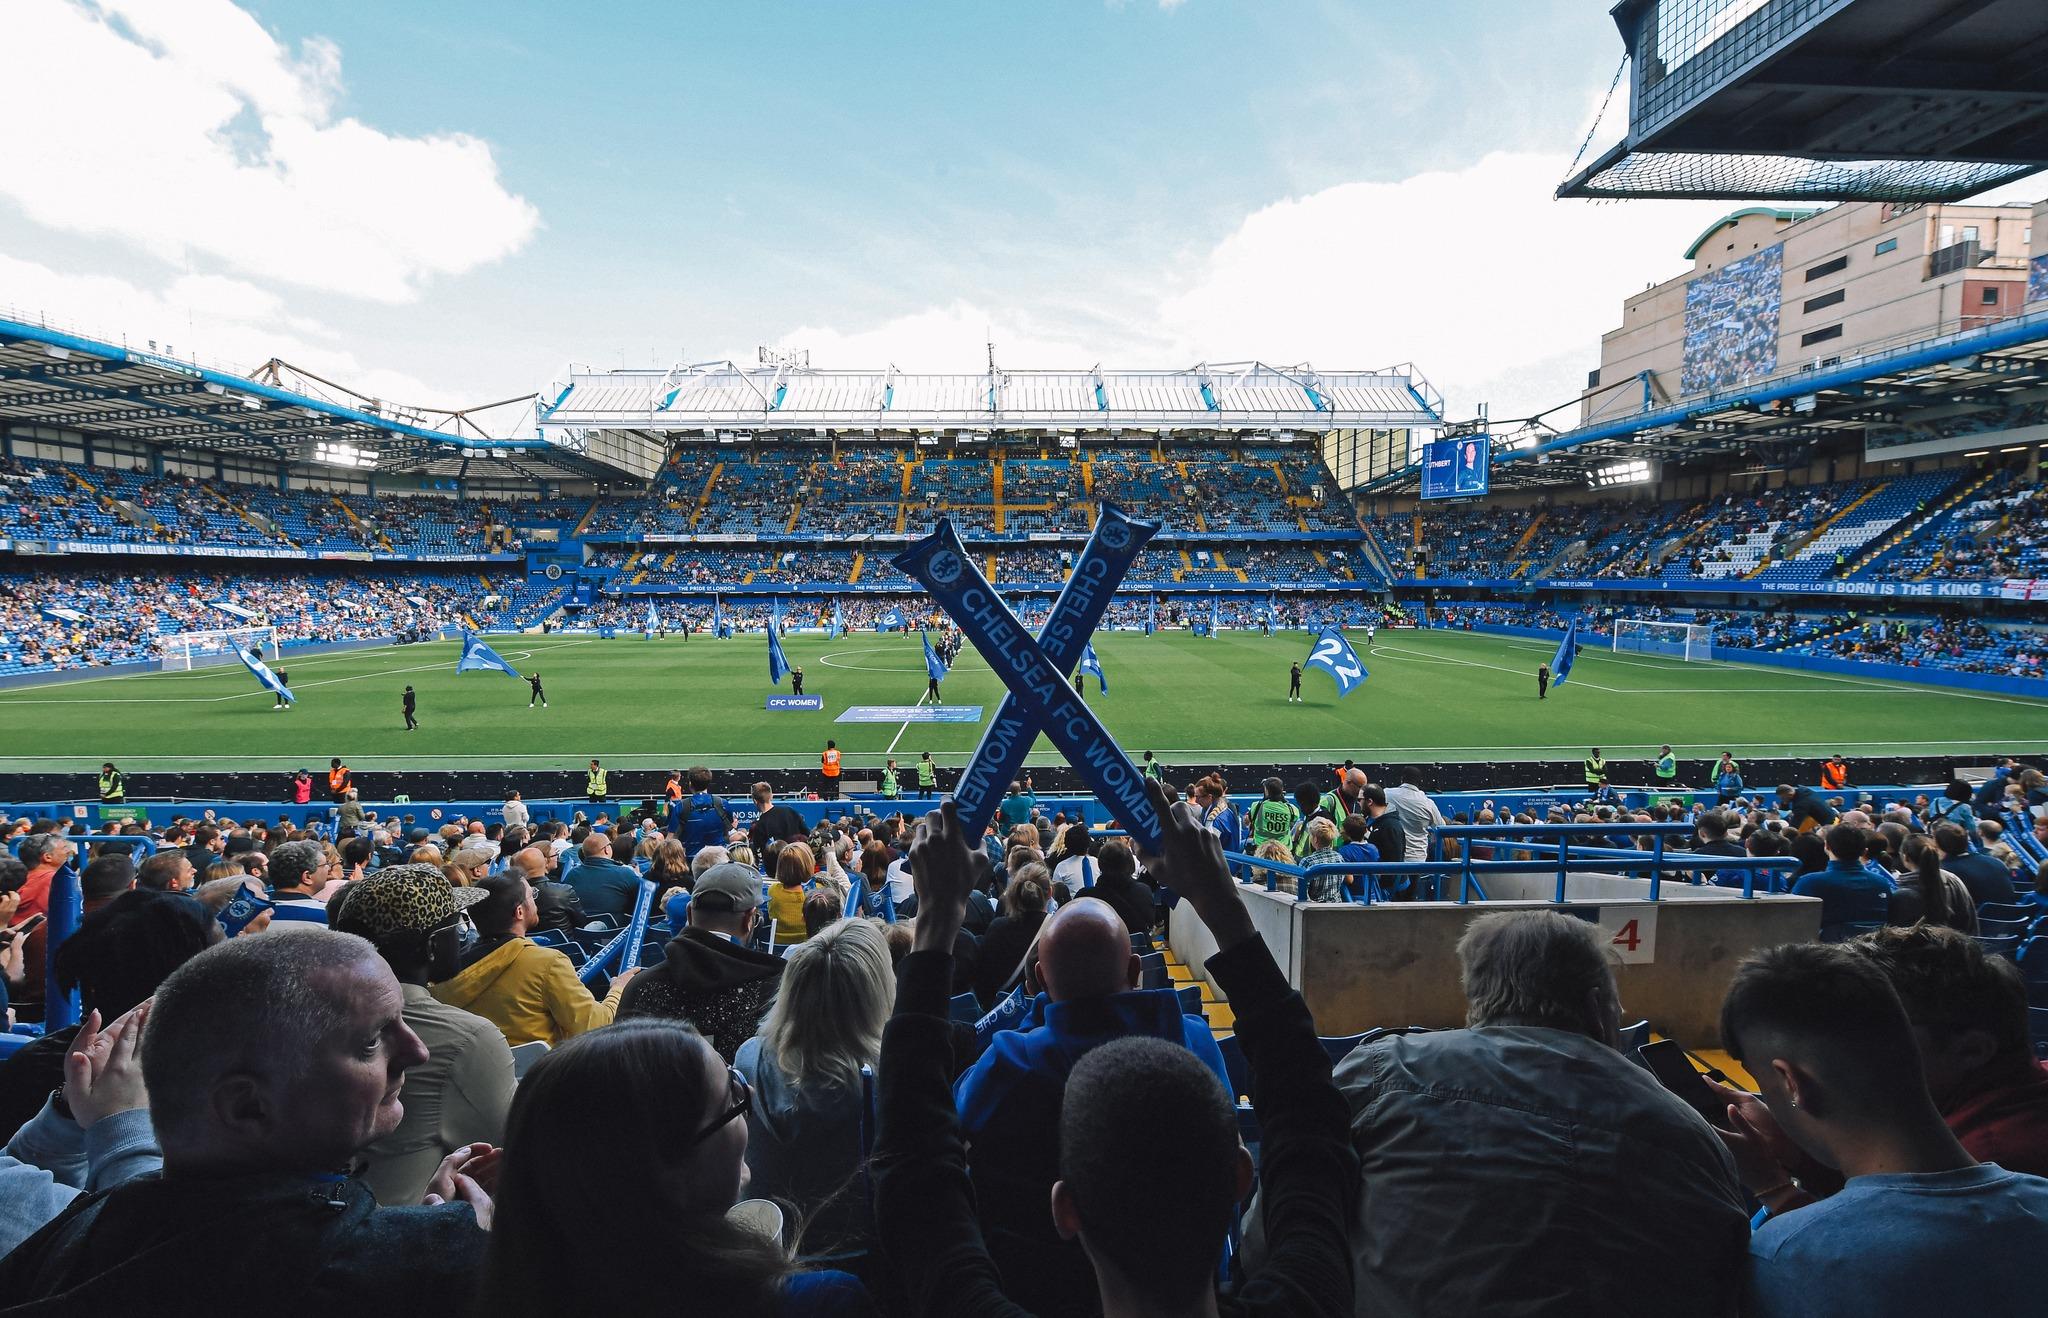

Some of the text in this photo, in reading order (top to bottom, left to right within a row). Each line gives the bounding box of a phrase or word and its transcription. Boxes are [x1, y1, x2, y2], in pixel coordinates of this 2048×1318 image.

[68, 542, 168, 554] CHELSEA OUR RELIGION
[193, 547, 228, 556] SUPER
[228, 548, 268, 558] FRANKIE
[269, 549, 307, 559] LAMPARD
[1836, 582, 1982, 595] BORN IS THE KING
[1042, 557, 1107, 657] CHELSE
[962, 588, 1162, 839] CHELSEA FC WOMEN
[956, 718, 1024, 824] WOMEN
[732, 811, 746, 819] NO
[1264, 811, 1288, 821] PRESS
[1266, 821, 1286, 832] 001
[1612, 919, 1642, 951] 4
